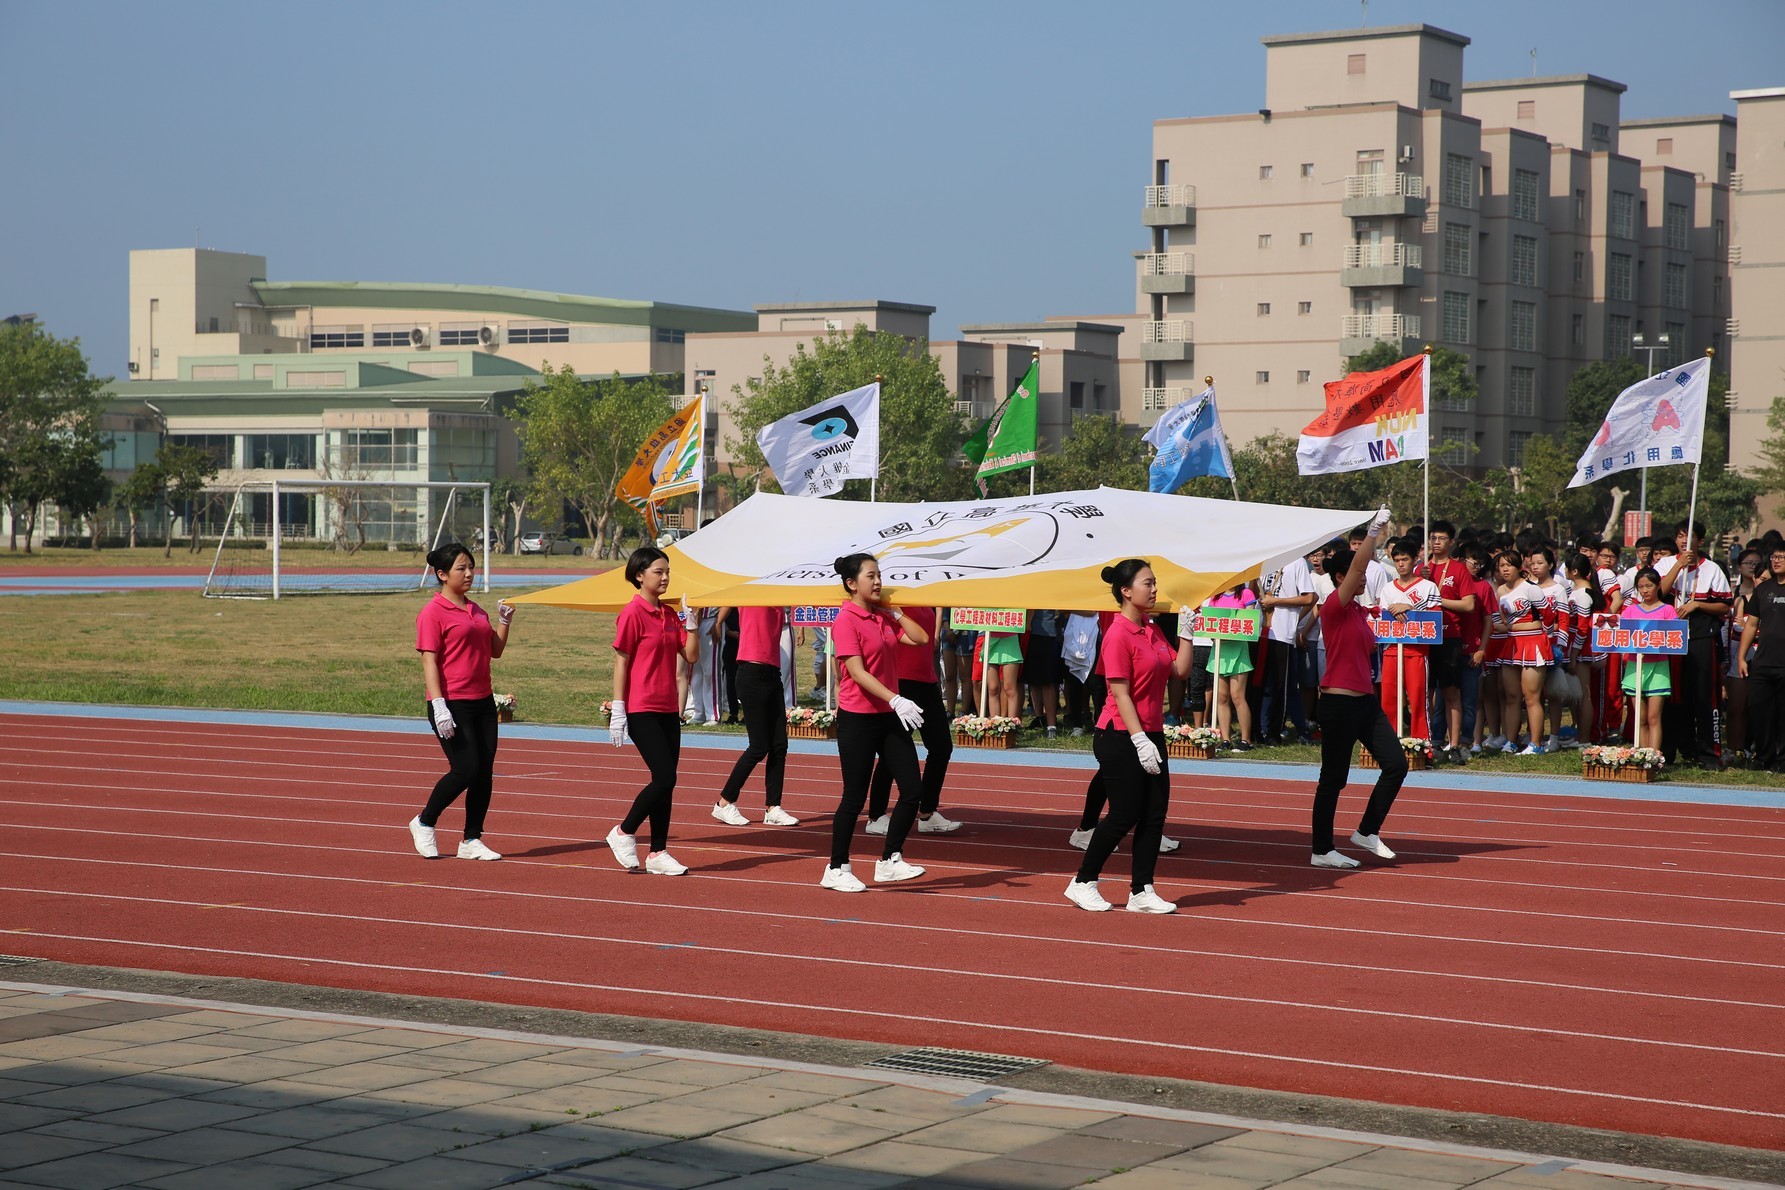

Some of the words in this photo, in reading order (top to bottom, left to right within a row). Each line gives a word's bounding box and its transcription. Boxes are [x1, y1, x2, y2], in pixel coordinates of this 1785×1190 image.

[889, 569, 928, 581] of
[1407, 589, 1423, 606] K
[795, 606, 841, 622] 金融管理
[953, 608, 1024, 627] 化學工程及材料工程學系
[1193, 615, 1255, 636] 訊工程學系
[1596, 628, 1684, 649] 應用化學系
